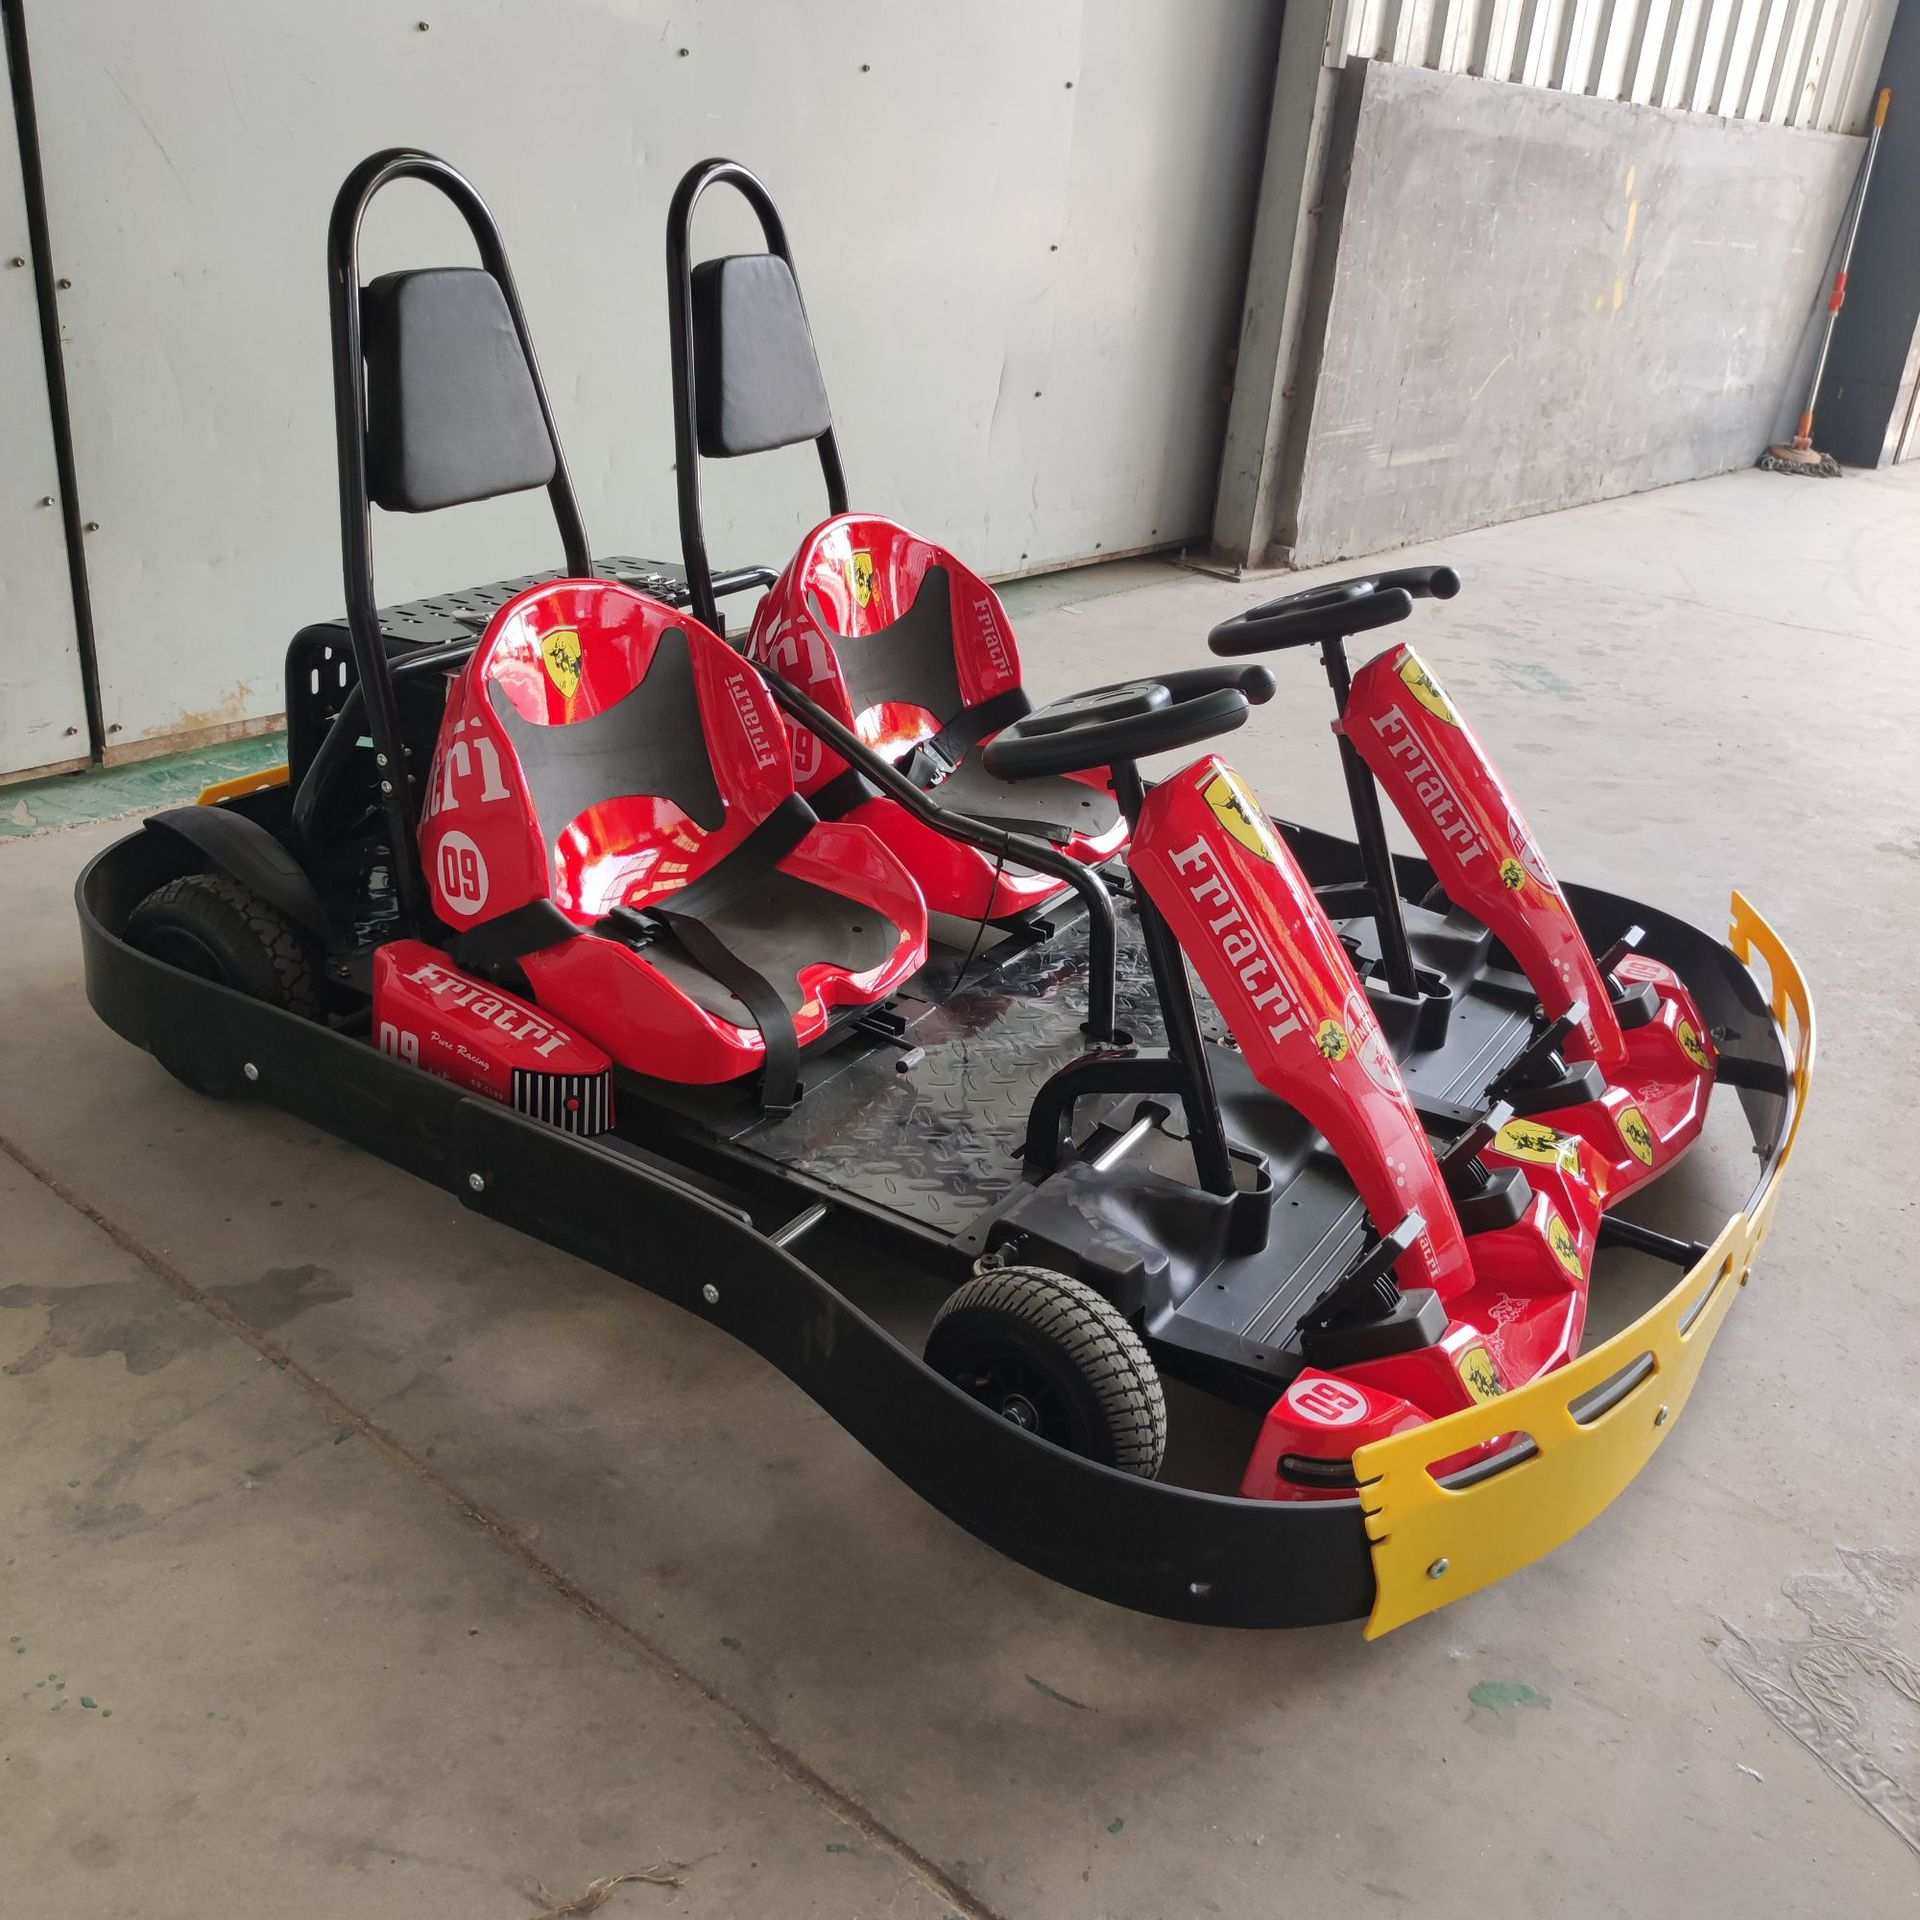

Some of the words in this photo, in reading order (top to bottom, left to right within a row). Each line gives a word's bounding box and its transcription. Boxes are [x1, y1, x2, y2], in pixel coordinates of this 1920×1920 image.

[973, 597, 1014, 679] Friatri
[724, 673, 777, 770] Friatri
[1369, 703, 1489, 868] Friatri
[442, 845, 481, 901] 09
[1168, 834, 1310, 1045] Friatri
[403, 962, 572, 1058] Friatri
[430, 1030, 455, 1051] Pure
[457, 1044, 490, 1072] Racing
[1295, 1382, 1359, 1421] 09
